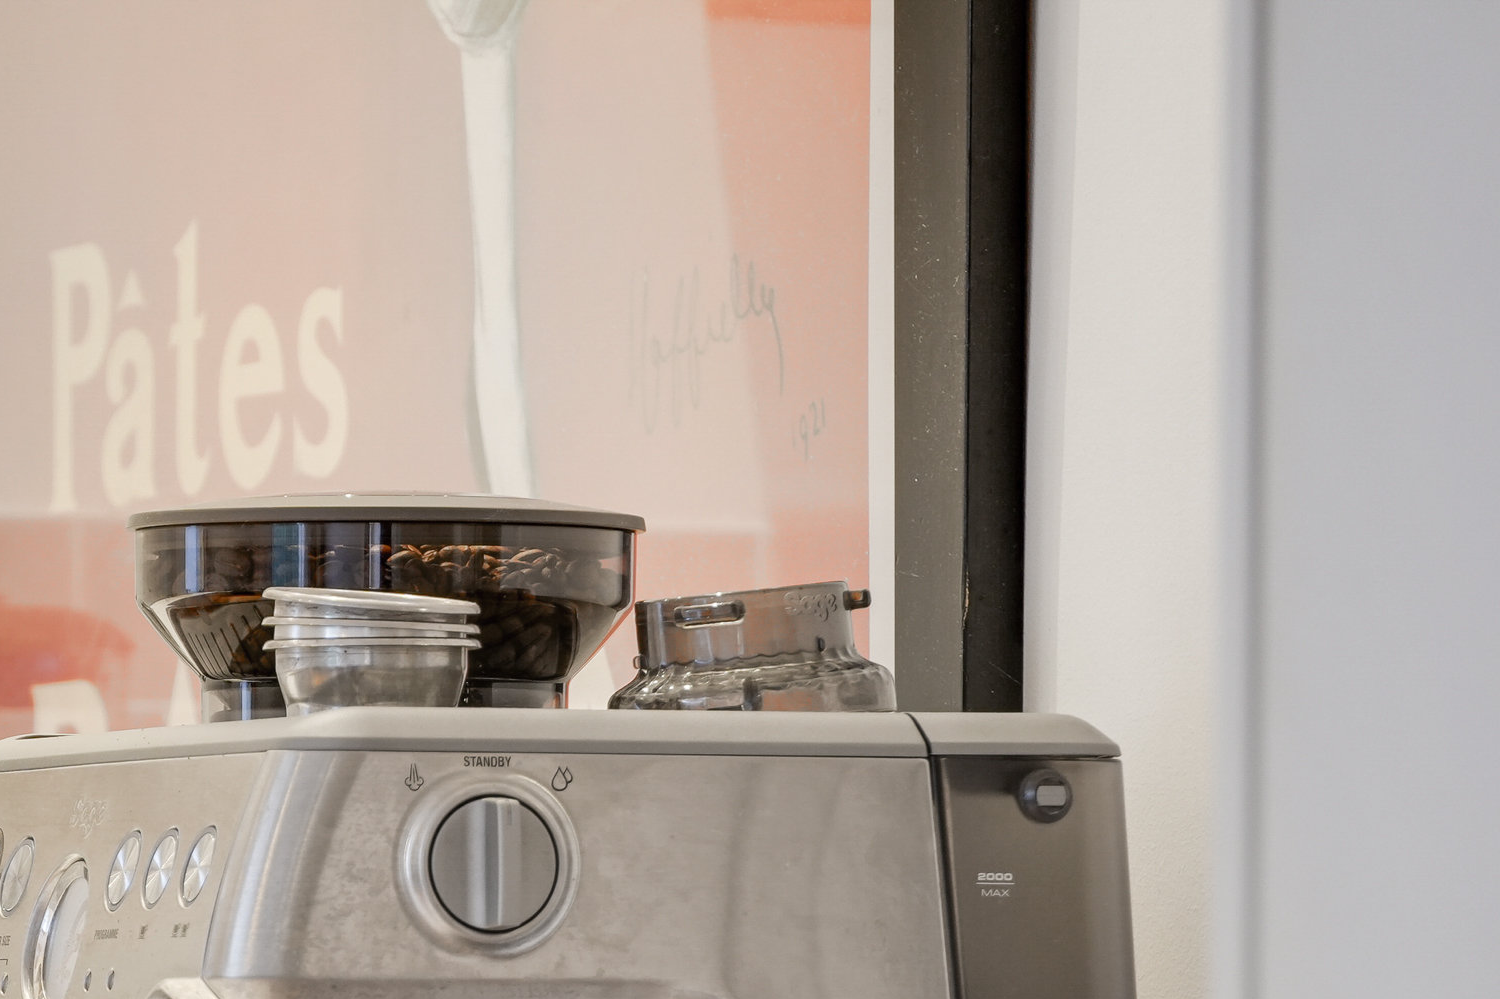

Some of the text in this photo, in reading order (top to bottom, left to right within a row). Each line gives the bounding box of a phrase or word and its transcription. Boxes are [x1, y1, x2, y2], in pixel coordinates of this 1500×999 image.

[49, 217, 348, 513] Pâtes
[783, 590, 838, 622] Sage
[463, 755, 512, 768] STANDBY
[977, 872, 1013, 881] 2000
[980, 888, 1010, 897] MAX
[94, 928, 119, 940] PROGRAMME
